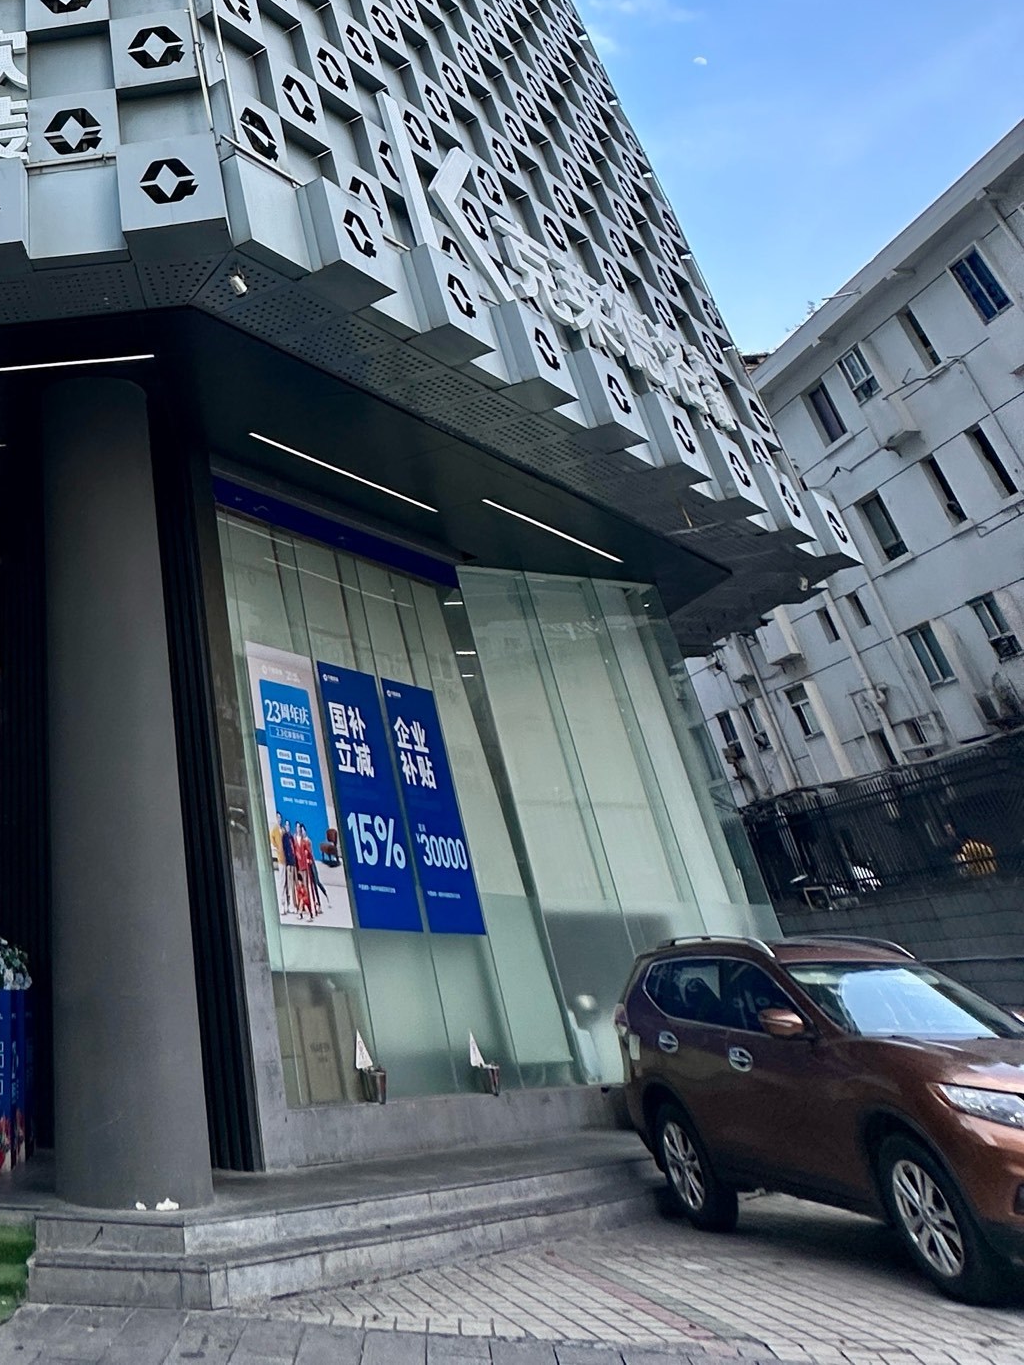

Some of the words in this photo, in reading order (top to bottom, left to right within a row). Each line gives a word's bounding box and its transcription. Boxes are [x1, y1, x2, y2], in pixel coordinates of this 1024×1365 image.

[264, 699, 311, 726] 23周年庆
[328, 701, 367, 741] 国补
[393, 715, 430, 754] 企业
[334, 738, 375, 778] 立减
[399, 750, 438, 790] 补贴
[347, 811, 407, 870] 15%
